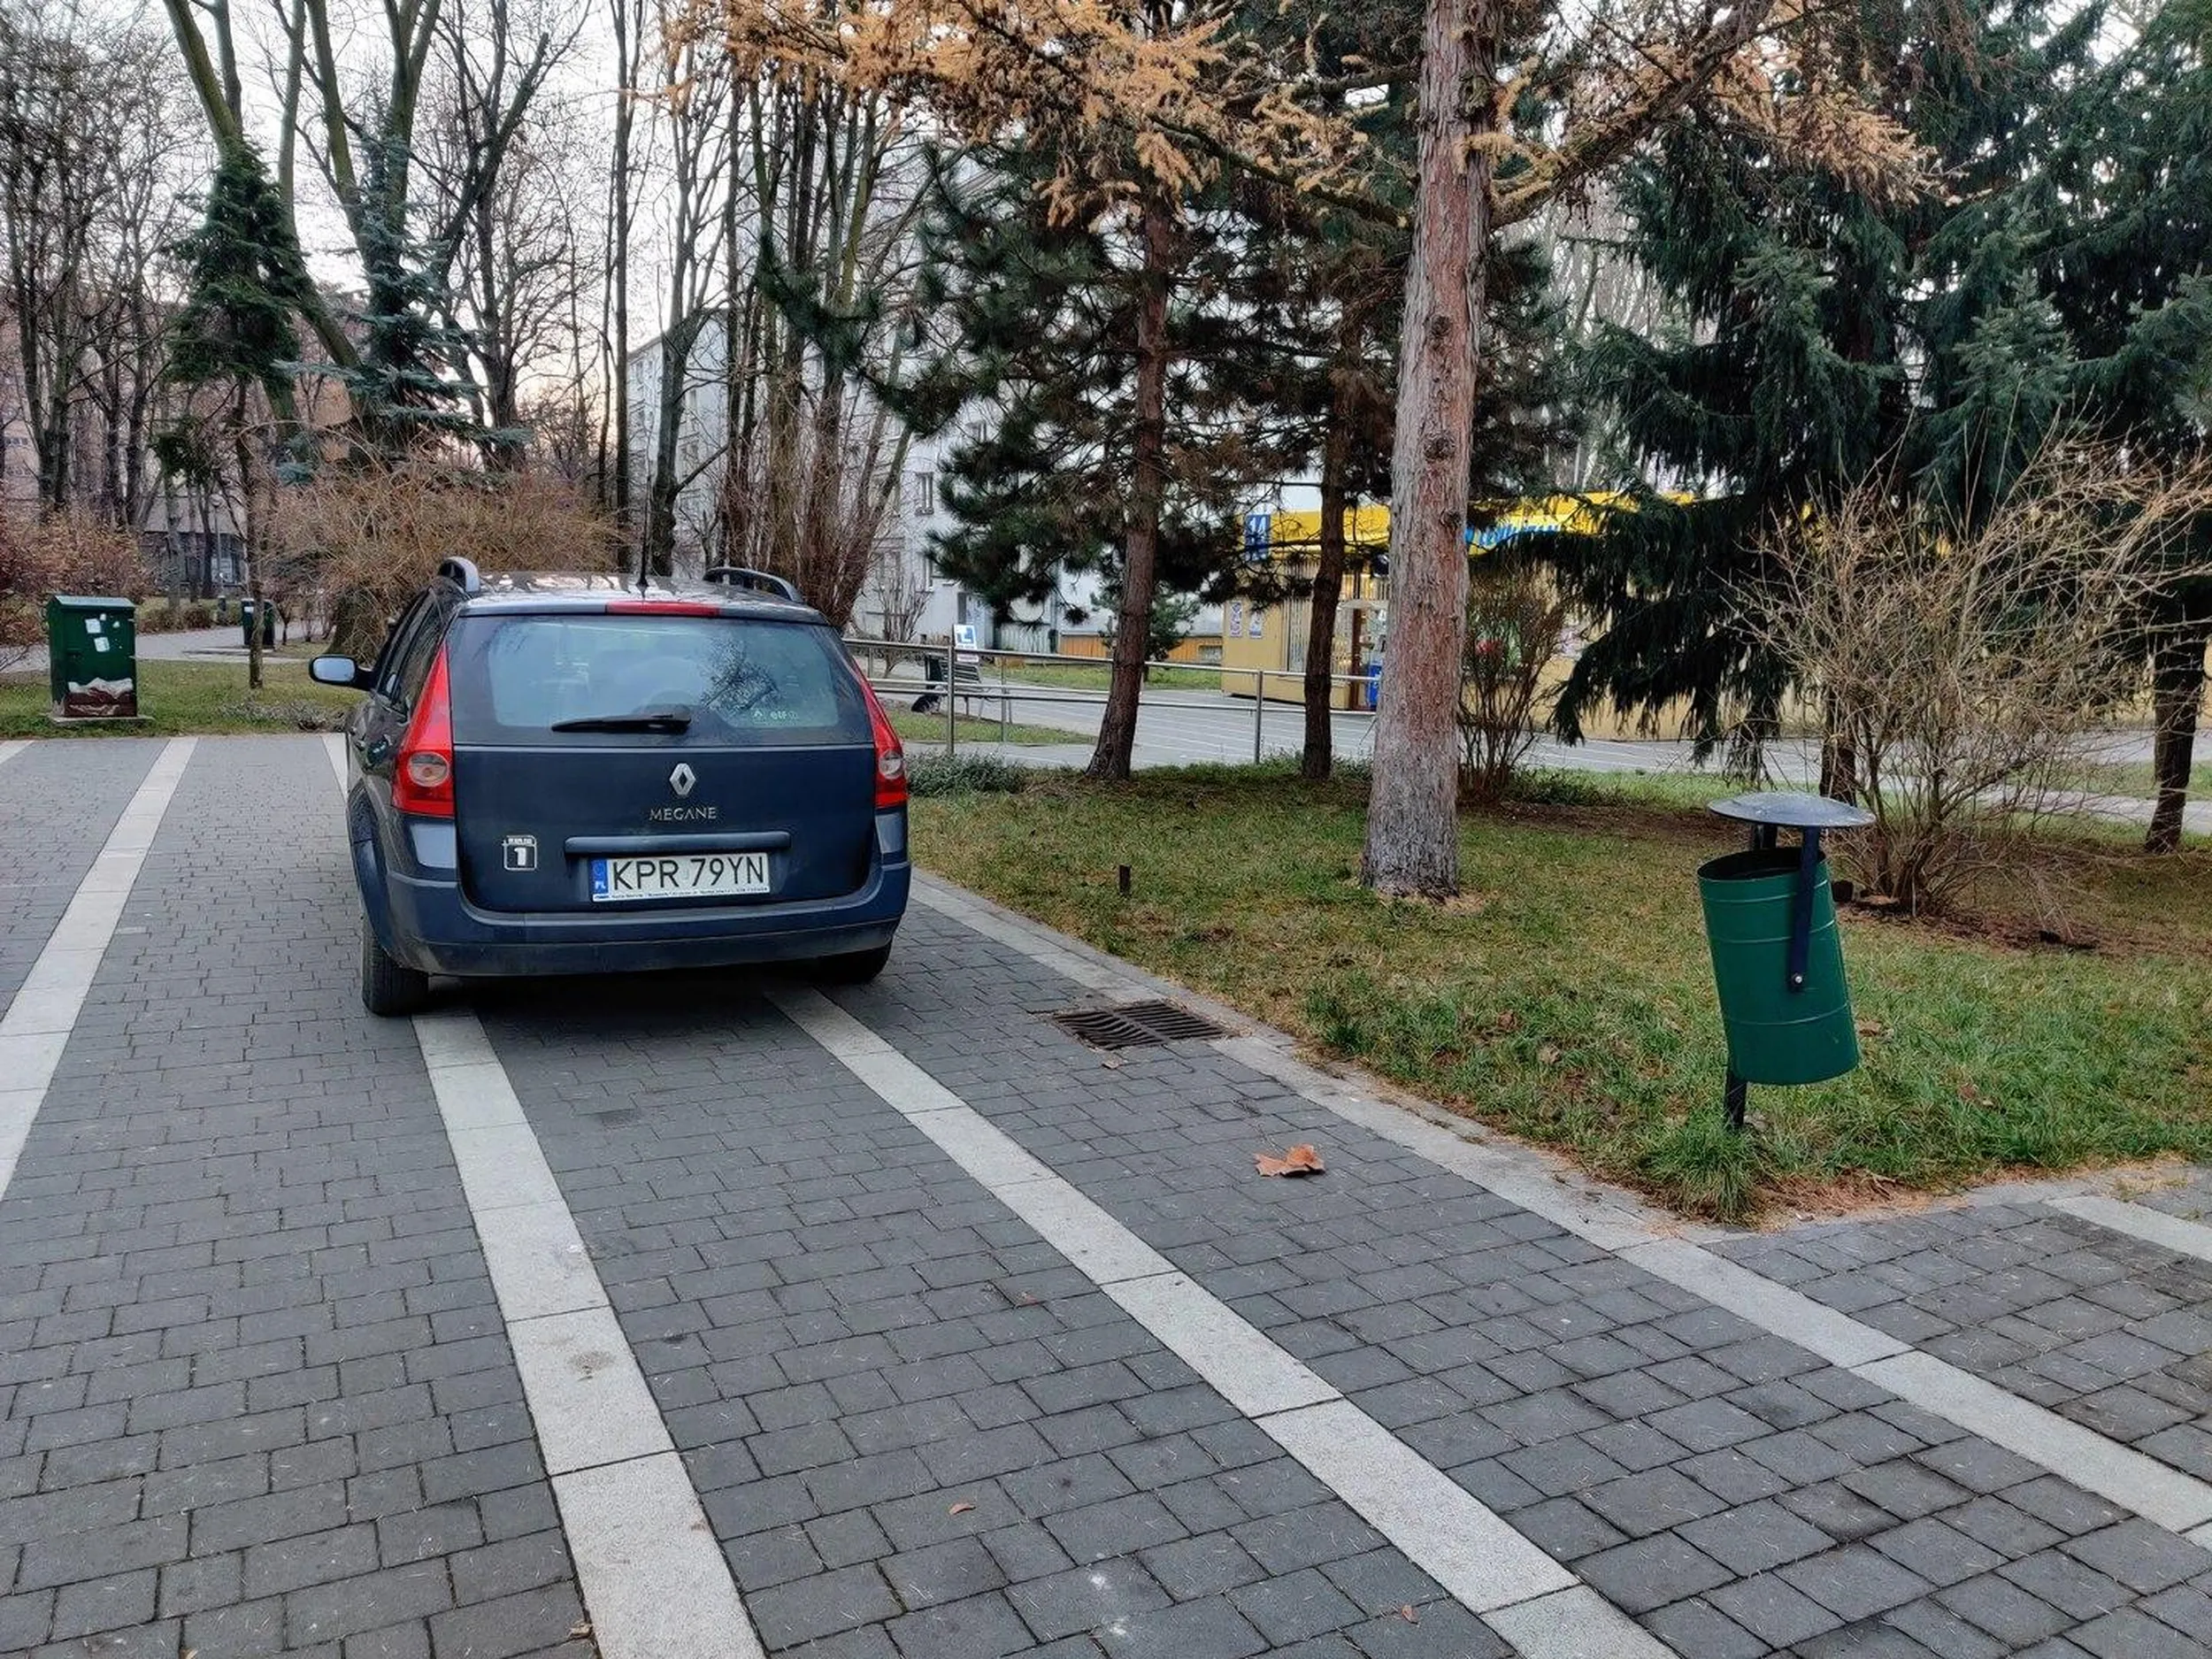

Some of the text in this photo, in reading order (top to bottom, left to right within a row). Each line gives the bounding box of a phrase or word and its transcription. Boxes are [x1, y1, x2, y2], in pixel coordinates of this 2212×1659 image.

[649, 807, 717, 821] MEGANE
[514, 847, 526, 866] 1
[613, 856, 764, 890] KPR 79YN
